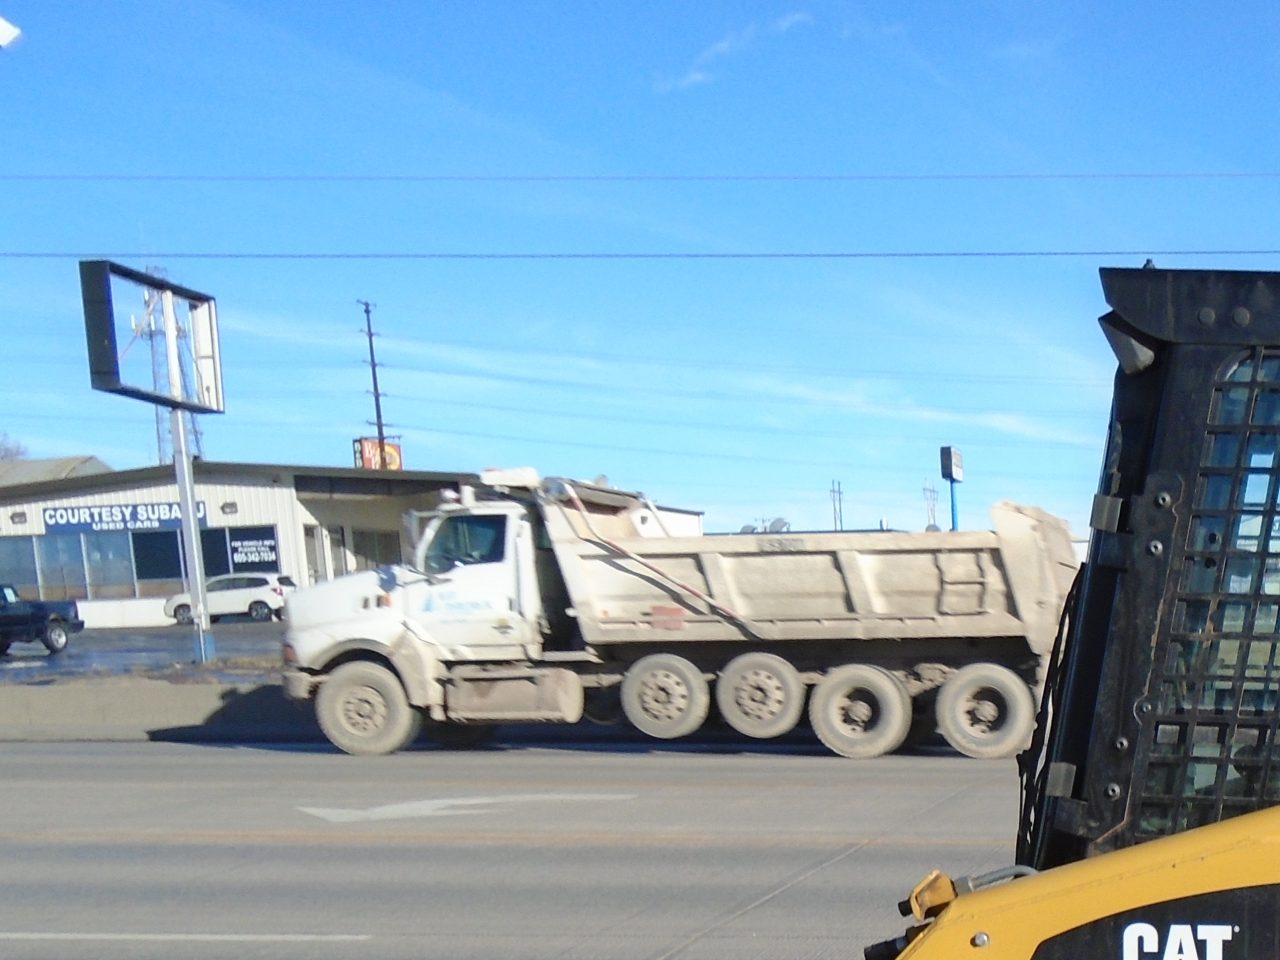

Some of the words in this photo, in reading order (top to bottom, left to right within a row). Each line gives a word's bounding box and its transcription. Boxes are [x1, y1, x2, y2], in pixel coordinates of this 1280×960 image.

[44, 506, 132, 524] COURTESY
[137, 502, 205, 519] SUBAU
[92, 522, 125, 531] USED
[127, 520, 160, 529] CARS
